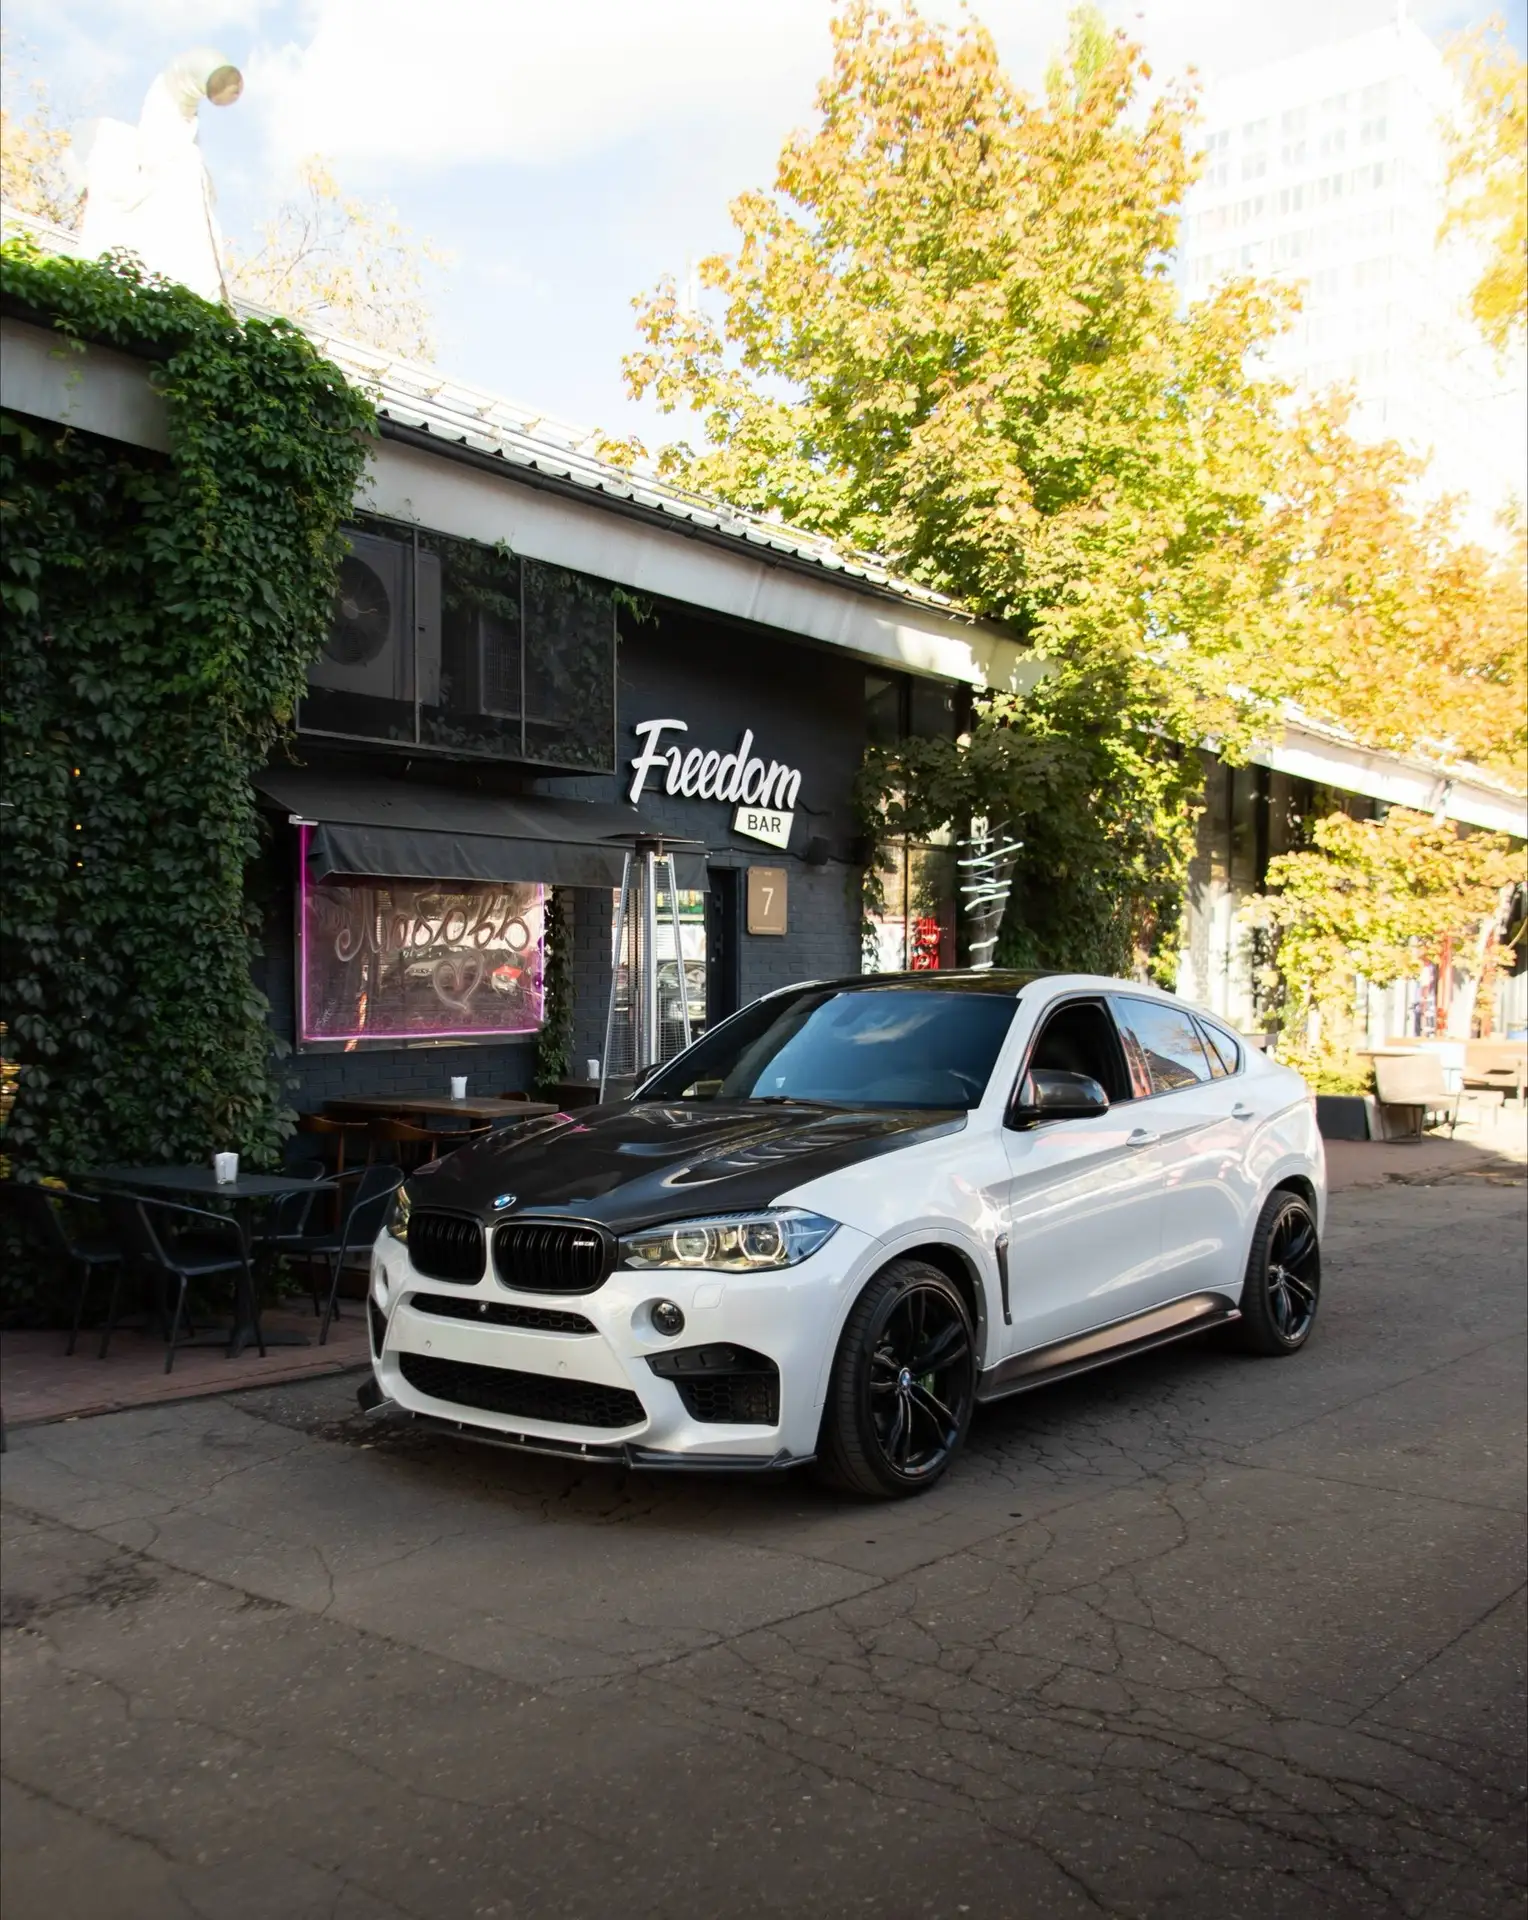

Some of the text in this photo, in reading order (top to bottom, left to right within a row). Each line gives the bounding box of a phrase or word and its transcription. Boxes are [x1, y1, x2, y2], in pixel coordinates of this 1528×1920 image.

[630, 718, 802, 810] Freedom
[747, 814, 781, 833] BAR
[762, 887, 774, 916] 7
